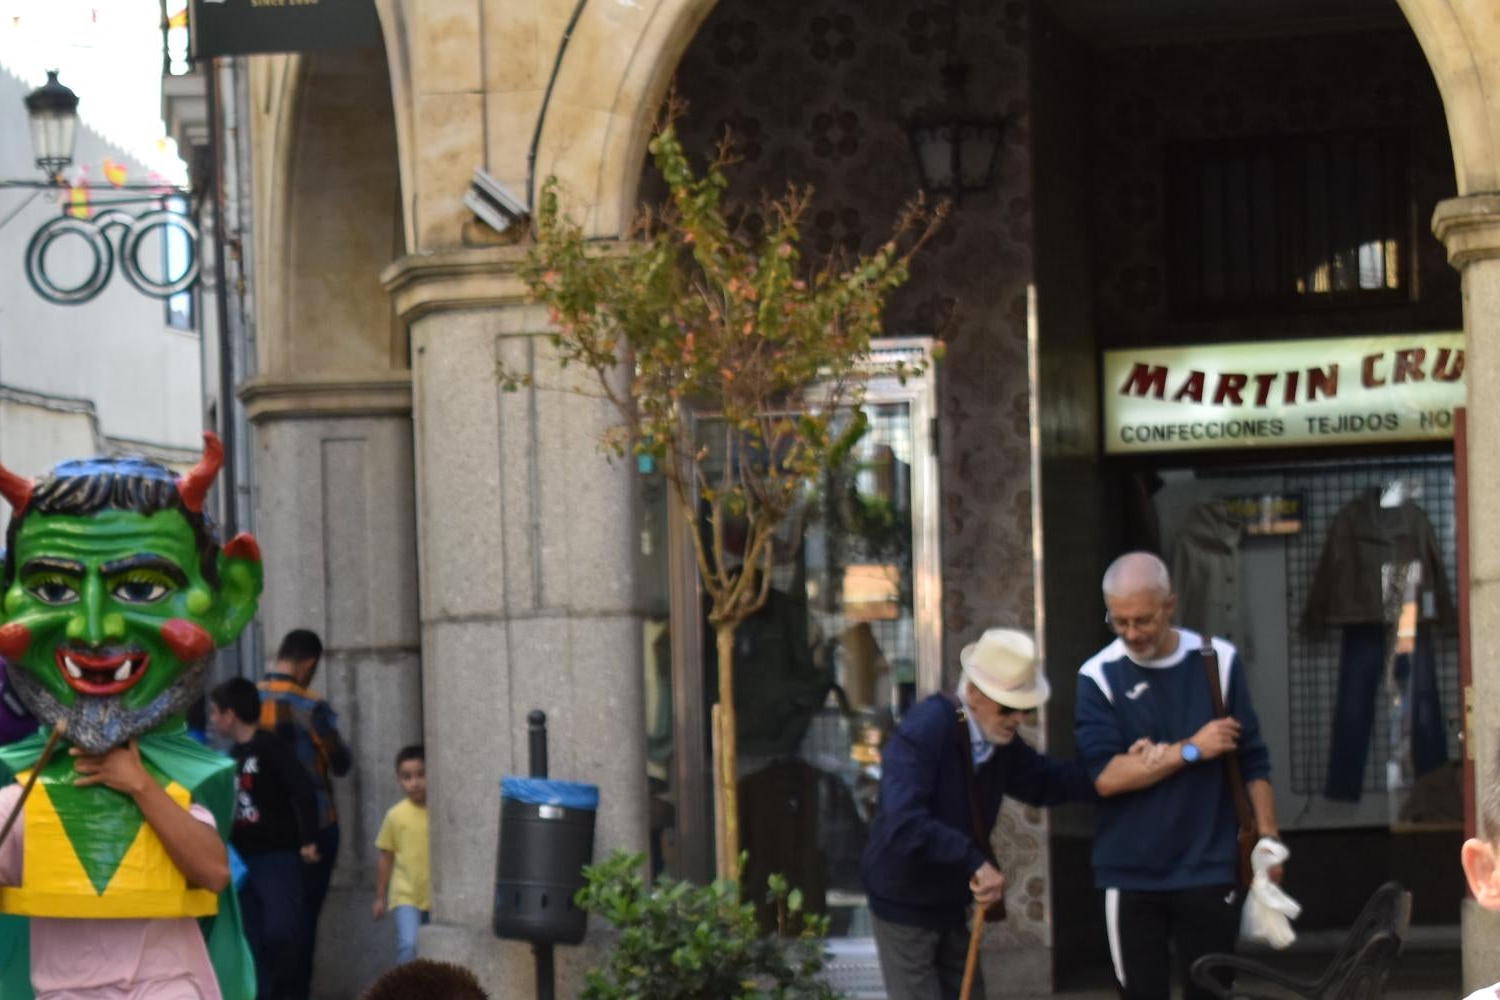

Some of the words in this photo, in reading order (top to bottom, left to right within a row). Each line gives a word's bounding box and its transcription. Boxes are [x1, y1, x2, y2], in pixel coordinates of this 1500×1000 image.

[1119, 362, 1340, 408] MARTIN
[1119, 418, 1285, 444] CONFECCIONES
[1305, 410, 1400, 436] TEJIDOS
